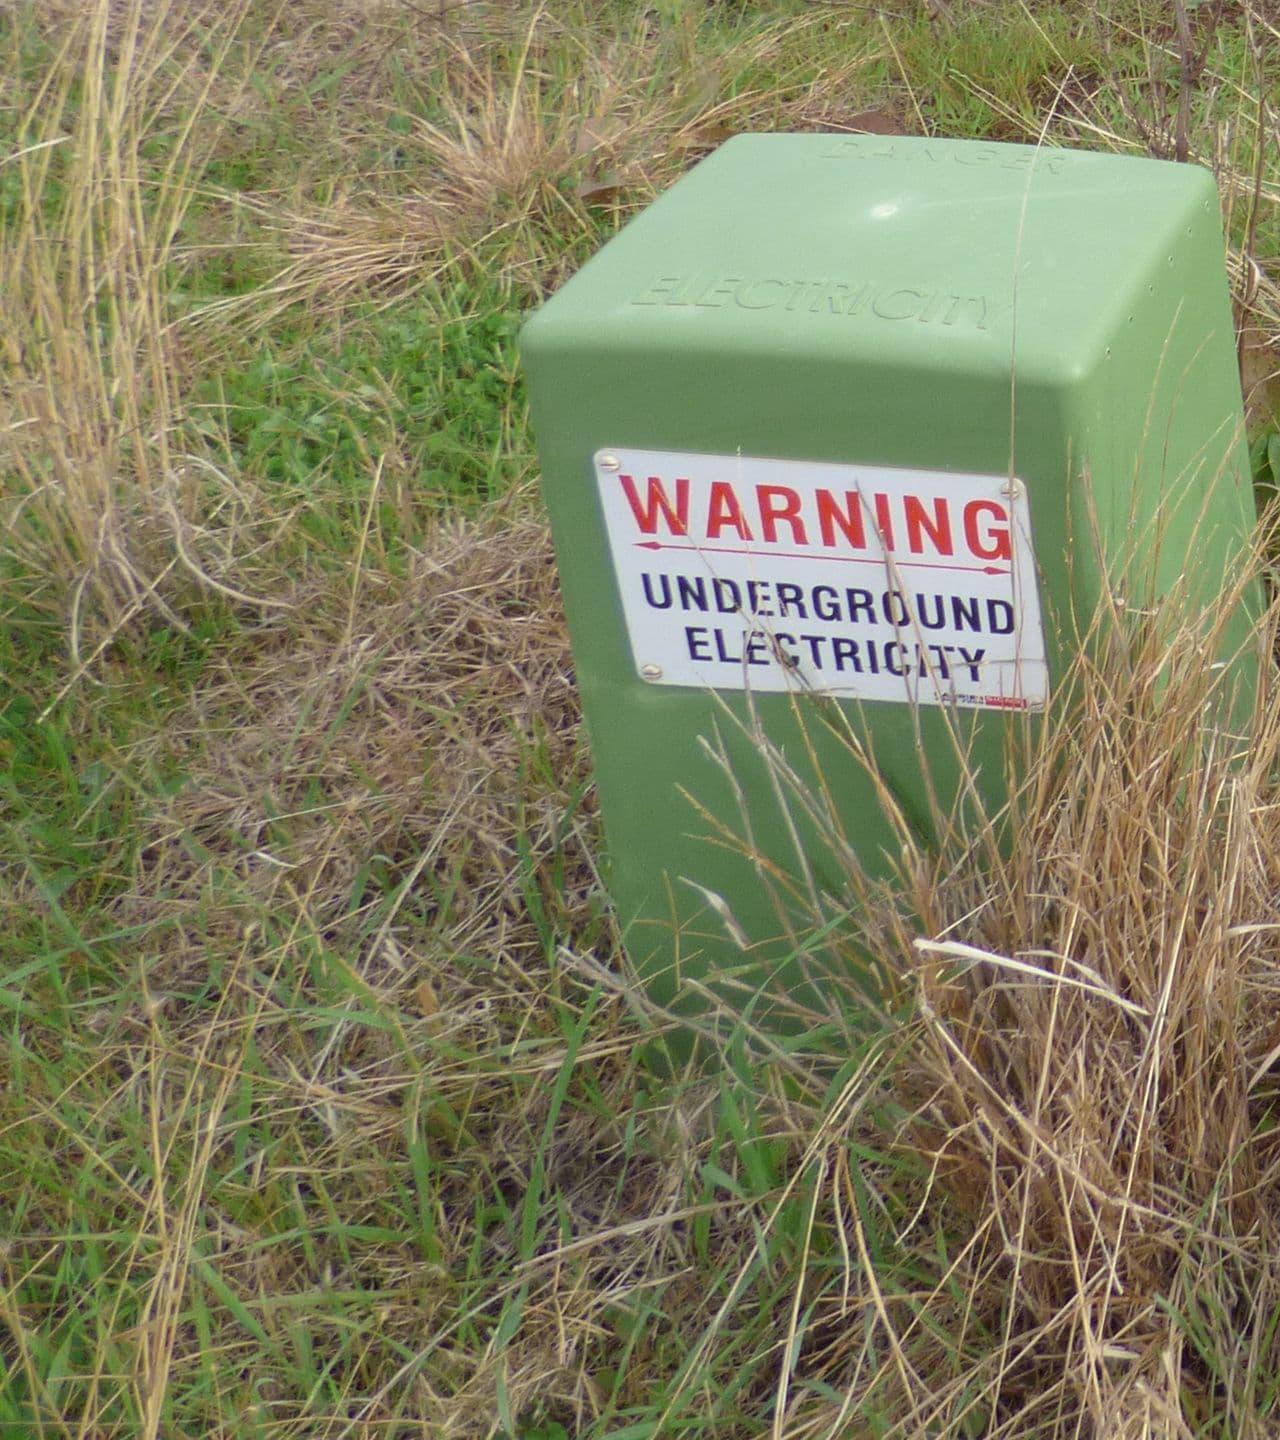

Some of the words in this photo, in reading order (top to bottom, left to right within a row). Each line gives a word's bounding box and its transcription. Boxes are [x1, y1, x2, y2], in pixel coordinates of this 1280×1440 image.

[631, 275, 1004, 330] ELECTRICITY
[619, 474, 1012, 561] WARNING
[641, 573, 1015, 635] UNDERGROUND
[685, 627, 985, 682] ELECTRICITY
